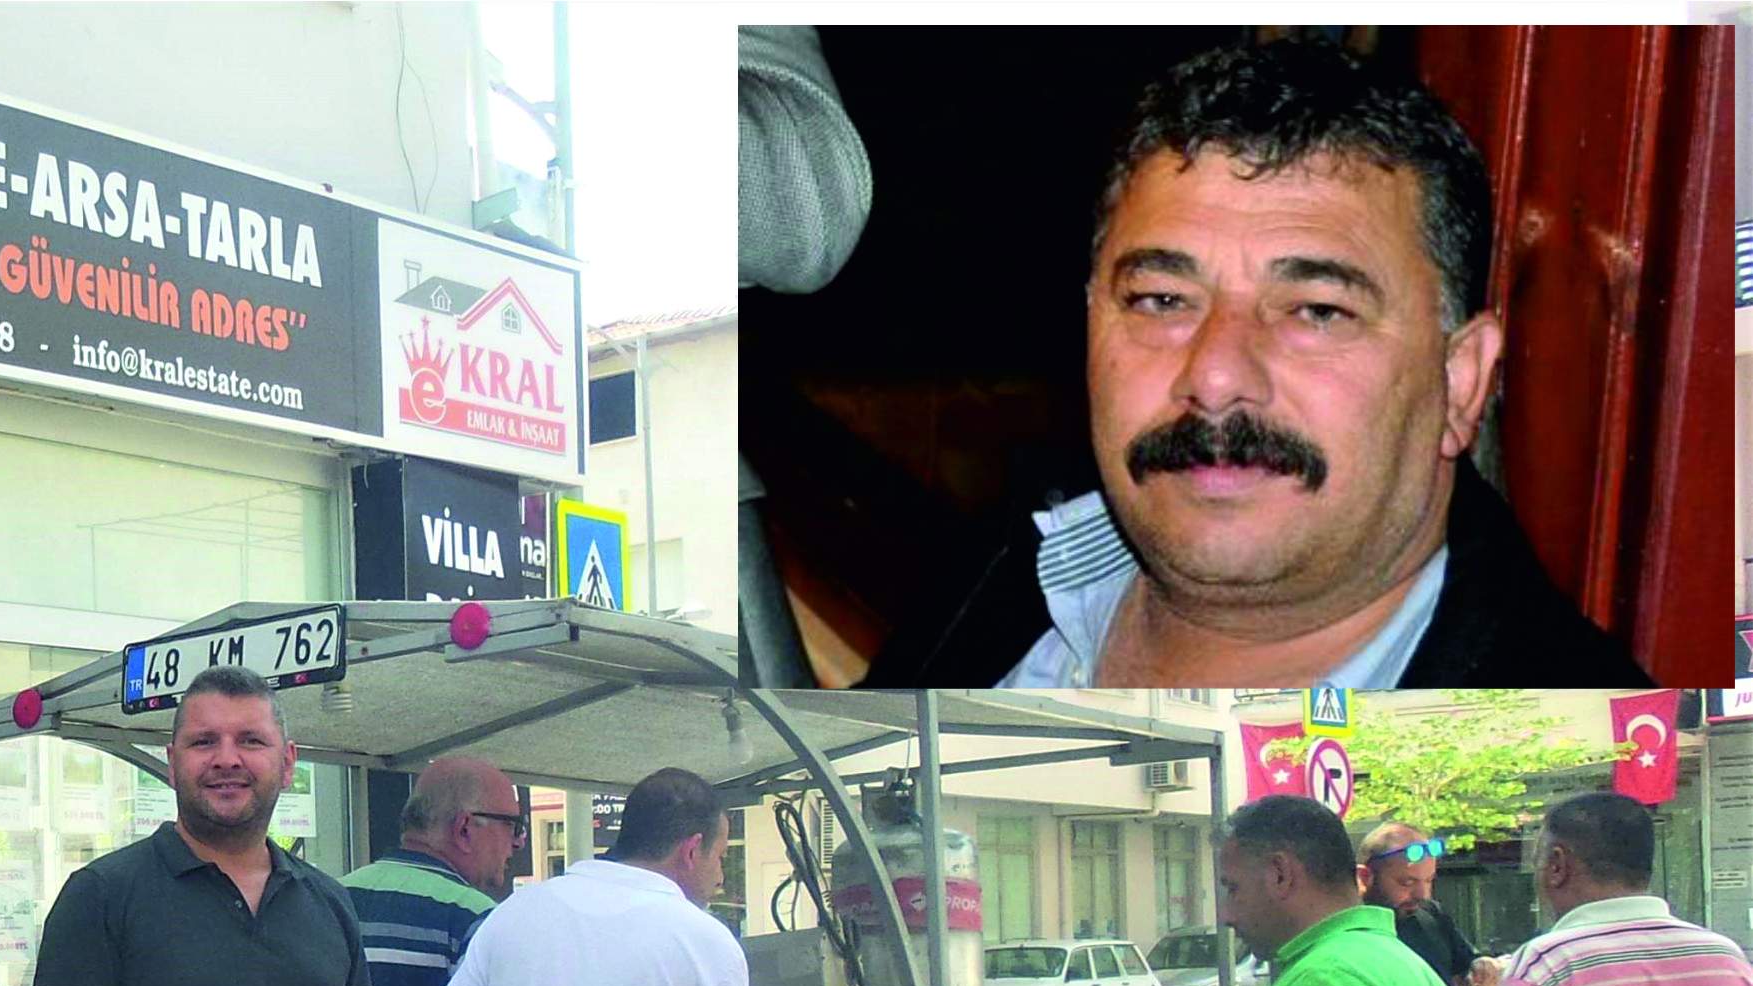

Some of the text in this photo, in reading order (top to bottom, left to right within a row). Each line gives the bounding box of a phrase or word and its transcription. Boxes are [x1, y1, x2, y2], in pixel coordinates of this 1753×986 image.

[73, 334, 304, 410] info@kralestate.com
[459, 342, 565, 414] KRAL
[467, 409, 560, 447] EMLAK & İNŞAAT
[422, 506, 505, 579] VİLLA
[129, 618, 334, 692] TR 48 KM 762
